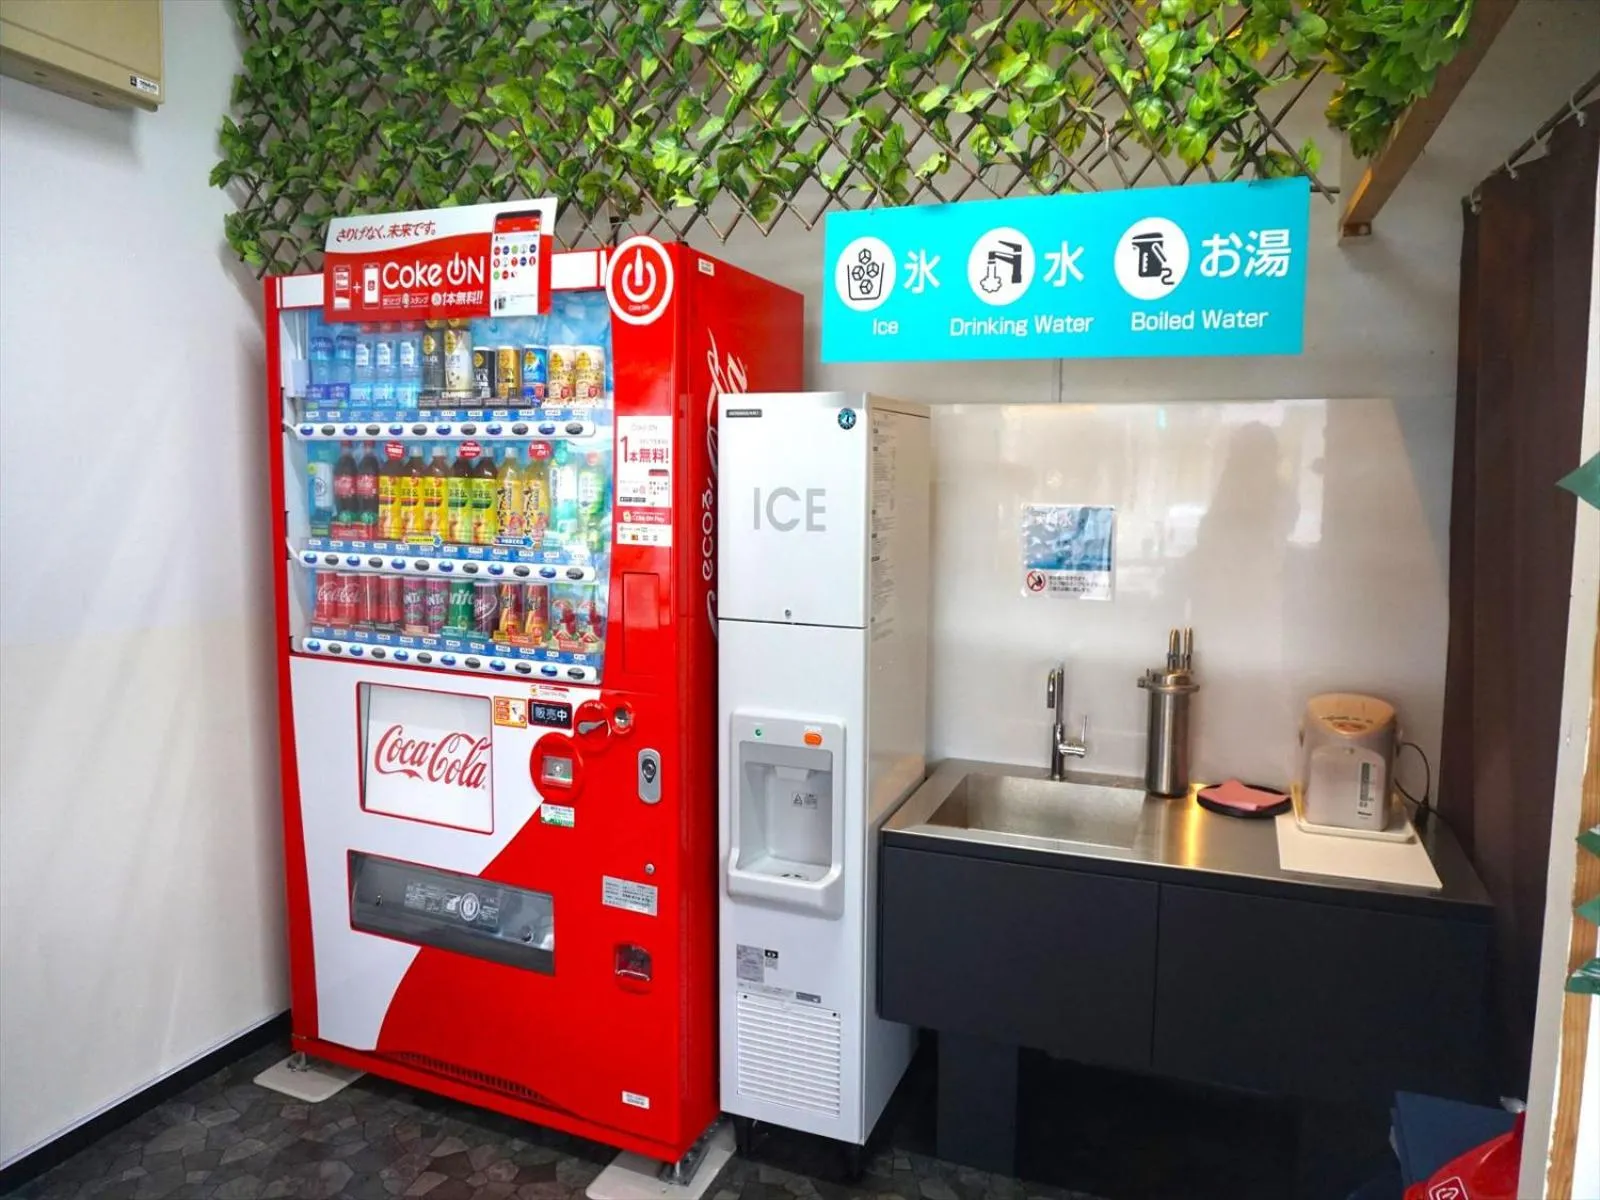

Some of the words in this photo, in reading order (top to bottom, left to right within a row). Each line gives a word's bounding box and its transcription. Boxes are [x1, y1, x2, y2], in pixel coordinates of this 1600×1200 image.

[336, 220, 437, 243] さりげなく、未来です。
[382, 260, 442, 289] Coke
[446, 252, 484, 286] ON
[903, 248, 941, 294] 氷
[1043, 240, 1085, 288] 水
[1200, 228, 1292, 278] お湯
[872, 318, 899, 336] Ice
[950, 317, 1029, 338] Drinking
[1034, 314, 1094, 335] Water
[1130, 309, 1195, 332] Boiled
[1202, 308, 1269, 330] Water
[753, 486, 827, 532] ICE
[375, 725, 491, 789] Coca-Cola
